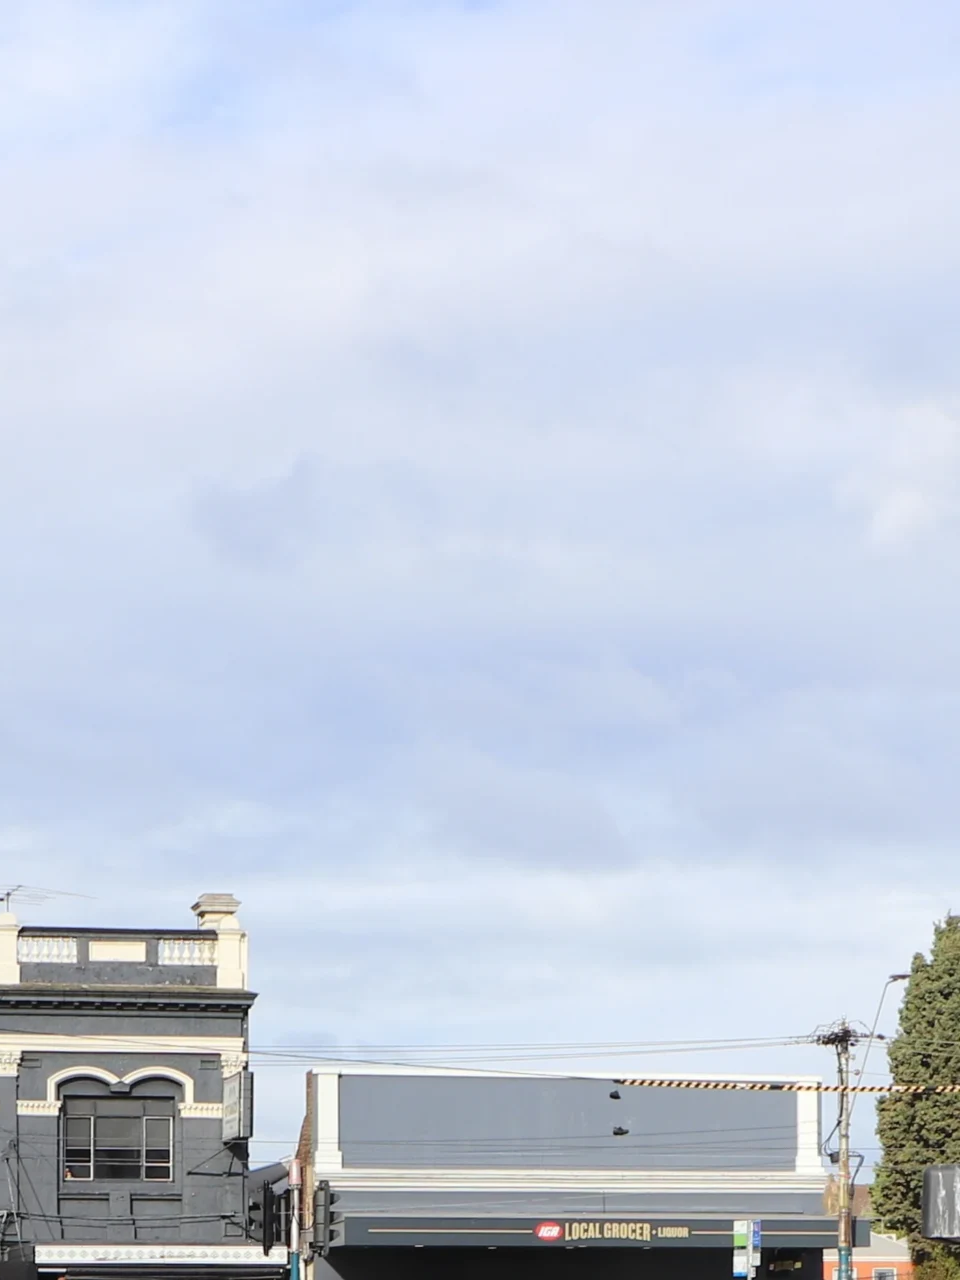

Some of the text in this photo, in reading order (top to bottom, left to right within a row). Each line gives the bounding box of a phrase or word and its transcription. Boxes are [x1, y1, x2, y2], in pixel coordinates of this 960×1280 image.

[538, 1222, 689, 1241] IGA LOCAL GROCER LIQUOR
